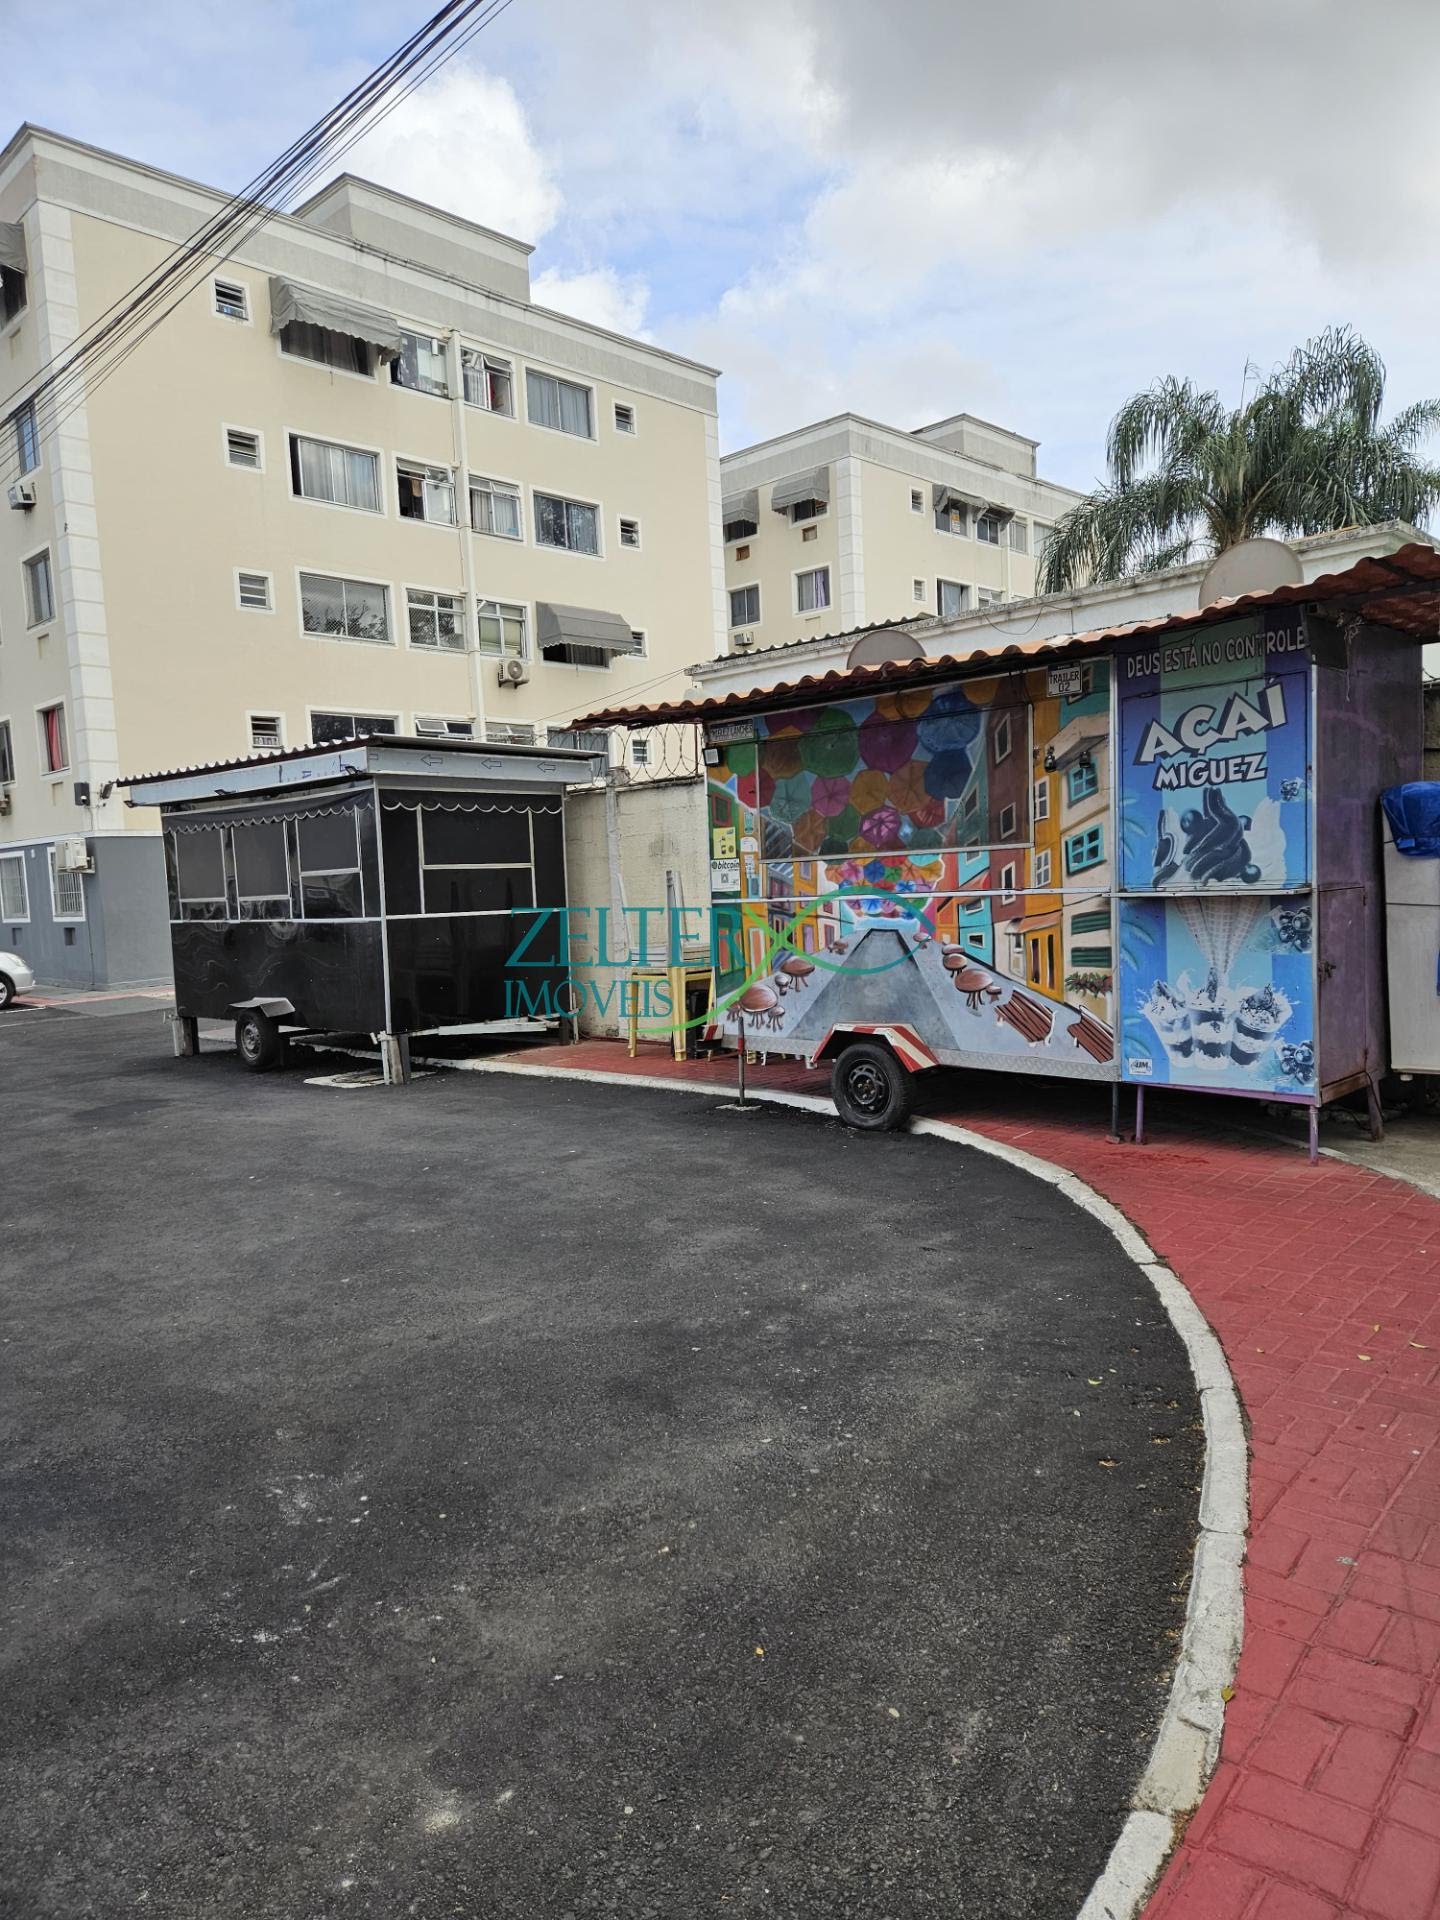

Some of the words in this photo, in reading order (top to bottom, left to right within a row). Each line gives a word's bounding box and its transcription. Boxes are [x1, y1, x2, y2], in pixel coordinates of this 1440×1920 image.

[1127, 652, 1161, 678] DEUS
[1164, 637, 1198, 673] ESTÁ
[1202, 641, 1222, 666] NO
[1226, 626, 1306, 661] CONTROLE
[1048, 671, 1080, 684] TRAILER
[1059, 682, 1071, 692] 02
[1136, 677, 1287, 763] AÇAÍ
[1154, 753, 1267, 790] MIGUEZ
